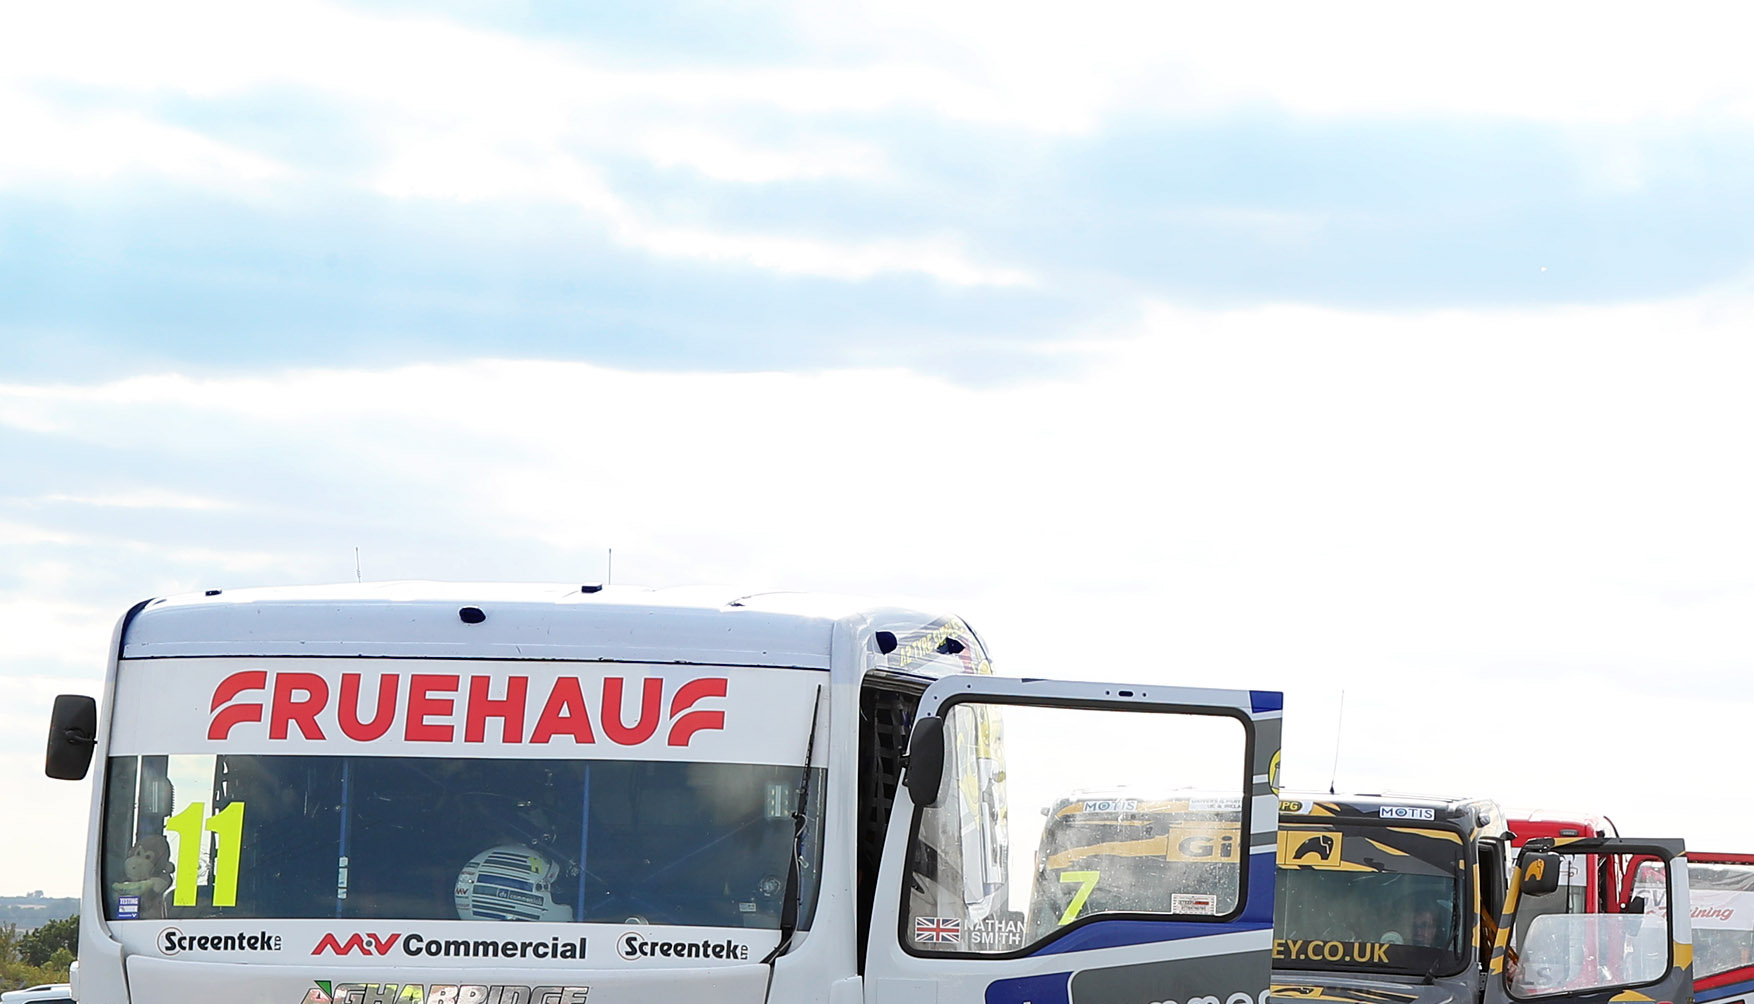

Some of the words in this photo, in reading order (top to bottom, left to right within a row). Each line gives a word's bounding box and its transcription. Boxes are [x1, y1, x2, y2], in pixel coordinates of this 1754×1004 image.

[207, 670, 728, 747] FRUEHAUF
[1381, 807, 1433, 819] MOTIS
[165, 801, 245, 907] 11
[1058, 870, 1100, 925] 7
[964, 920, 1025, 932] NATHAN
[972, 932, 1021, 944] SMITH
[164, 931, 273, 951] Screentek
[402, 934, 587, 959] Commercial
[624, 935, 739, 959] Screentek
